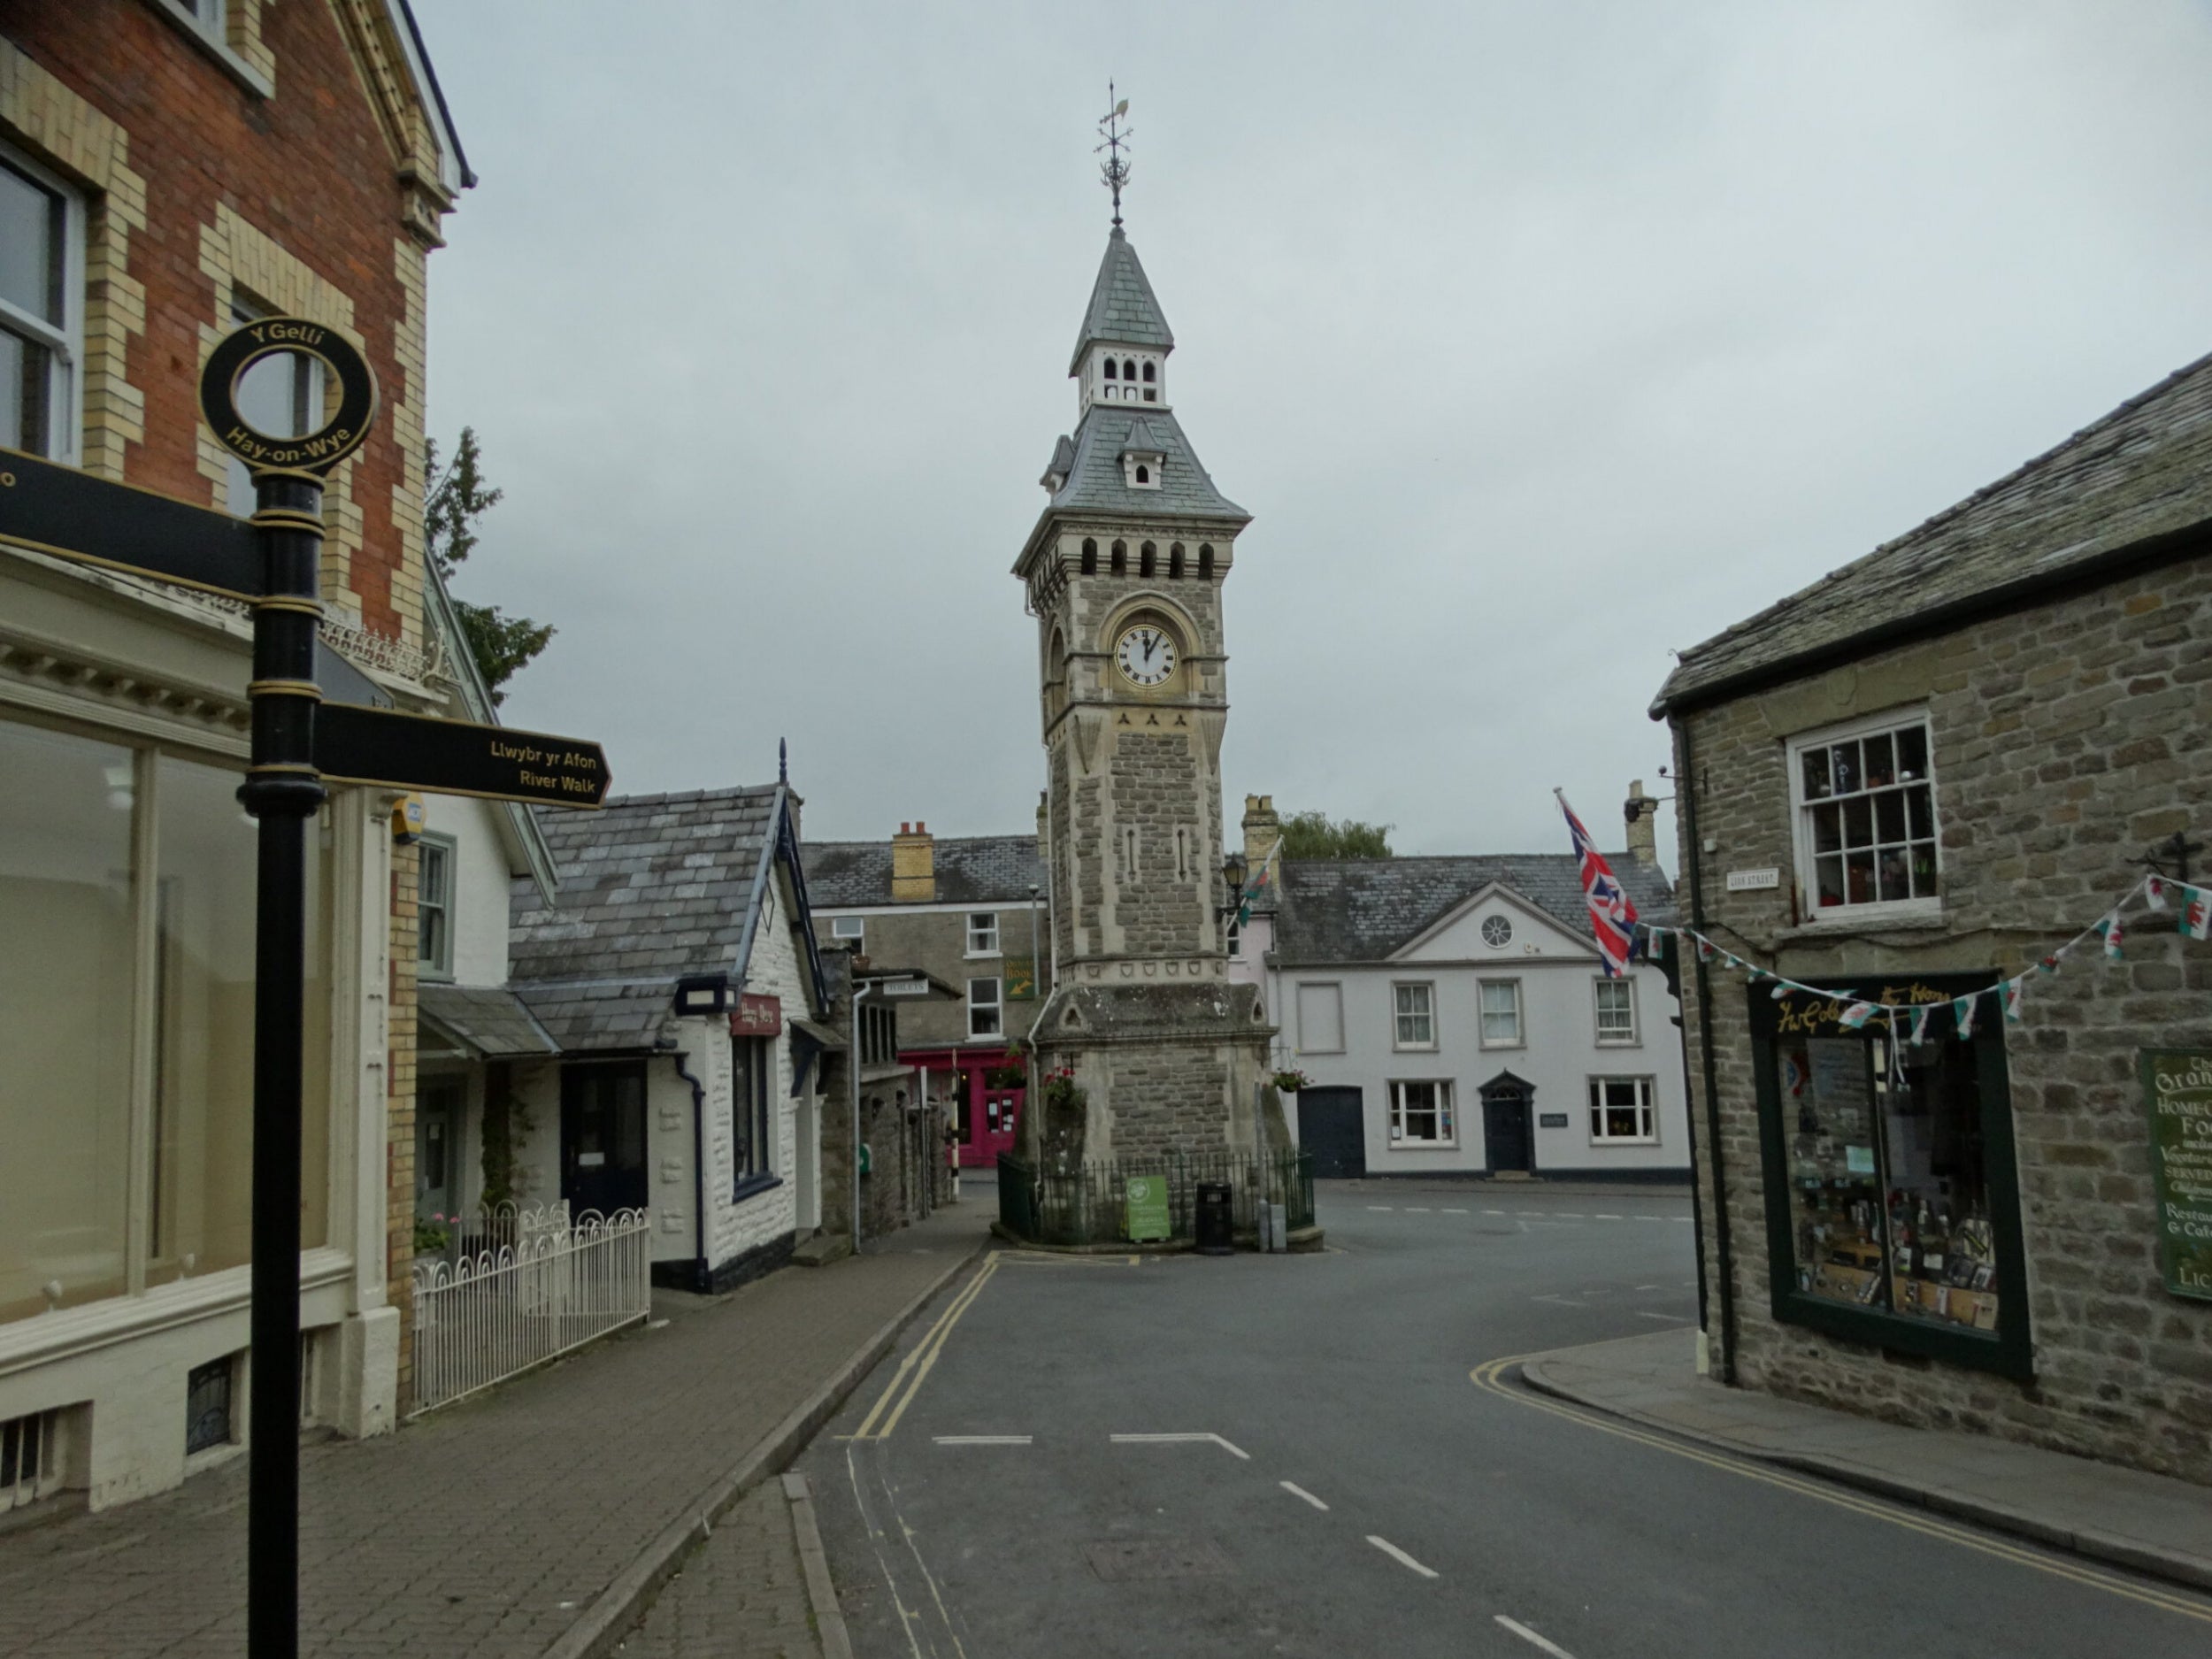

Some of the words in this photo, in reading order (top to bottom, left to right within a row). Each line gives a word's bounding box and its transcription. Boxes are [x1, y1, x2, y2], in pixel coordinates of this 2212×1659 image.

[250, 326, 265, 343] Y
[269, 323, 326, 345] Gelli
[226, 426, 351, 462] Hay-on-Wye
[491, 741, 541, 762] Llwybr
[546, 753, 560, 766] yr
[564, 752, 597, 769] Afon
[520, 770, 557, 788] River
[561, 776, 595, 794] Walk
[2182, 1117, 2212, 1136] Fo
